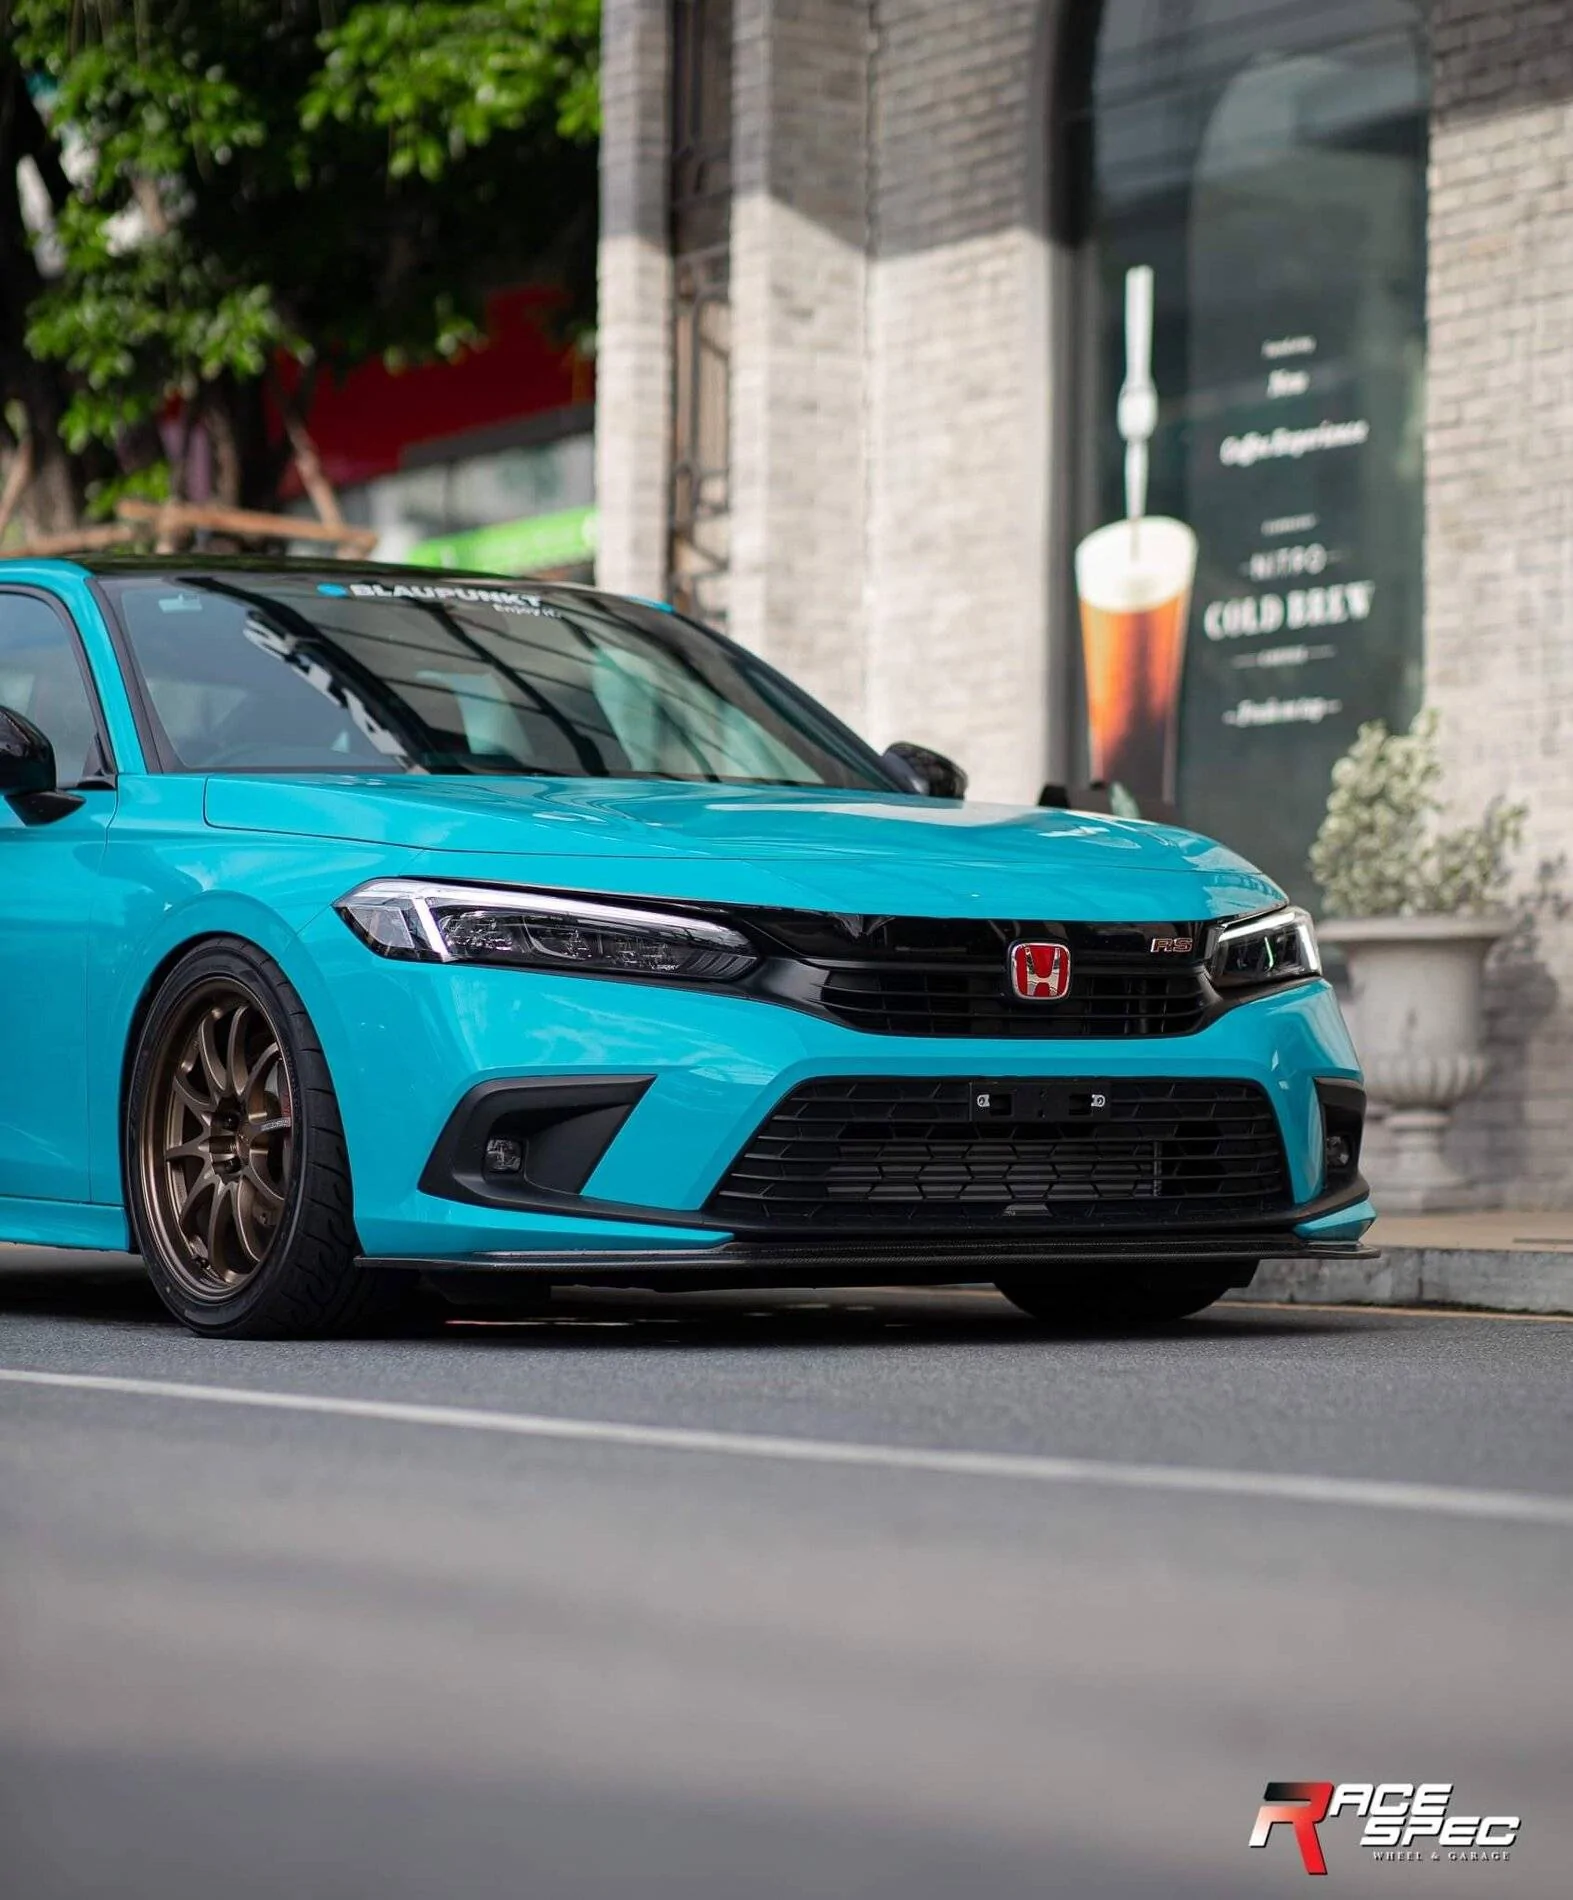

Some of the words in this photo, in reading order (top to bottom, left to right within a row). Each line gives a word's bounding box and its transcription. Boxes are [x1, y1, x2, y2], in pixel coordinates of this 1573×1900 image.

[349, 583, 541, 607] BLAUPUNKT
[1204, 593, 1284, 640] COLD
[1287, 580, 1375, 629] BREW
[1150, 938, 1193, 953] RS
